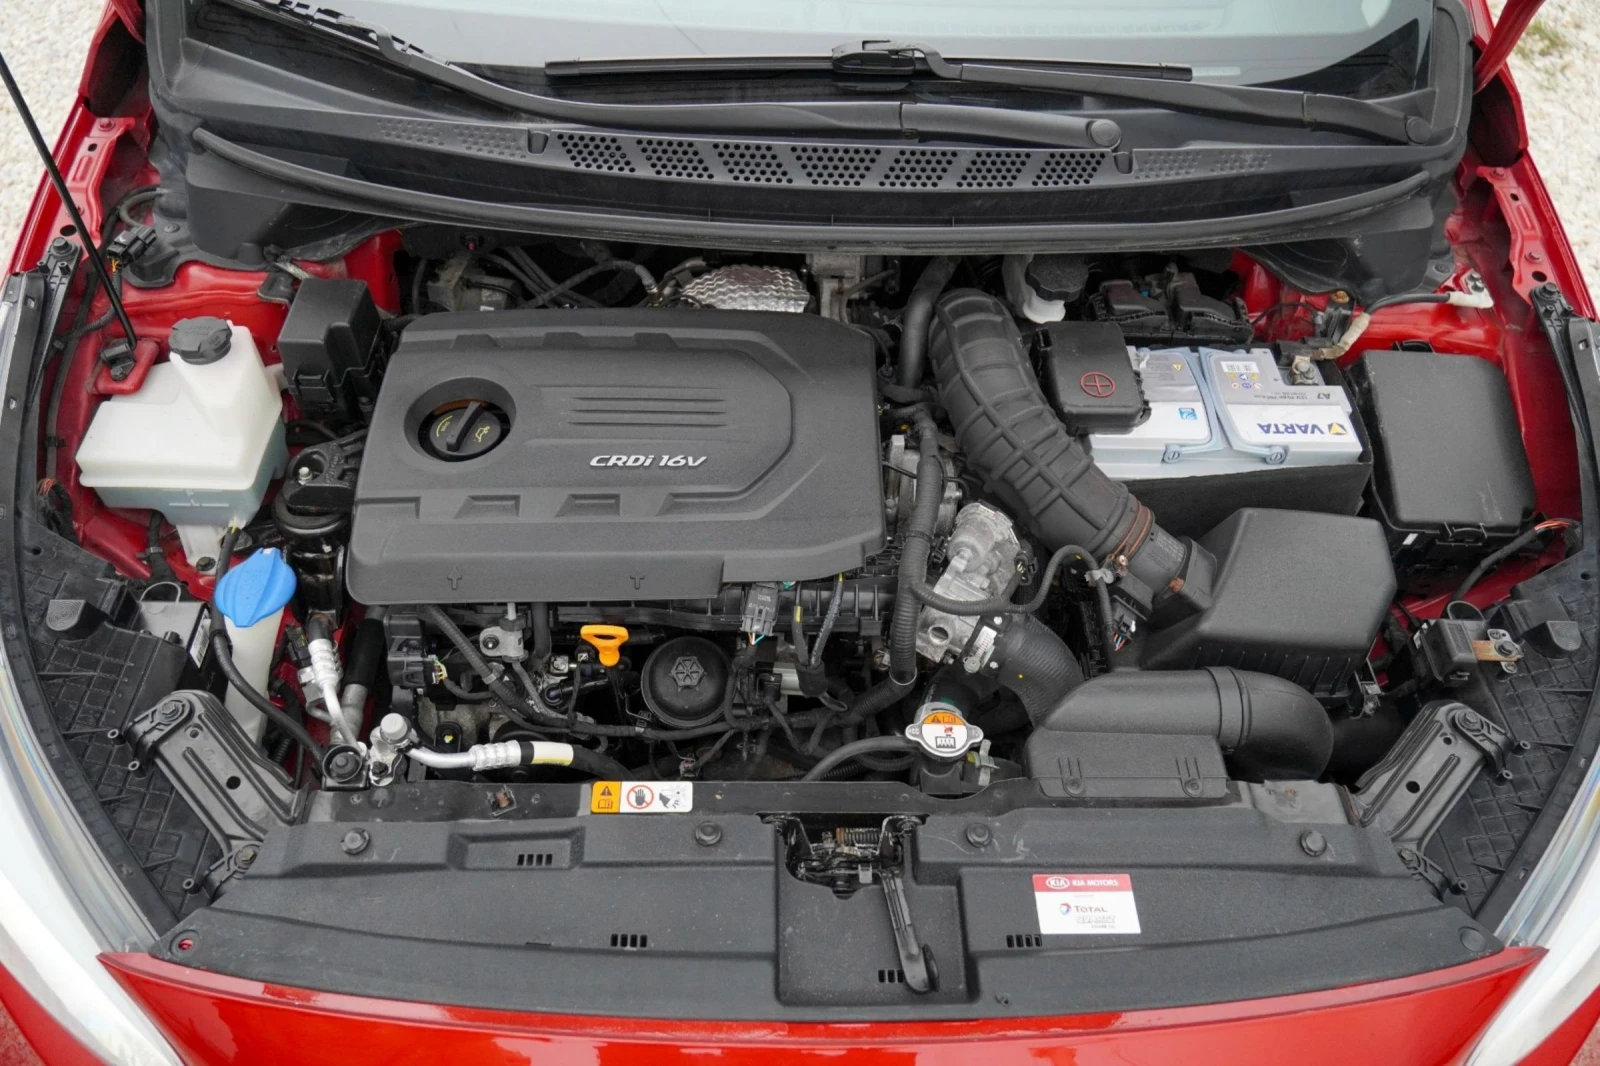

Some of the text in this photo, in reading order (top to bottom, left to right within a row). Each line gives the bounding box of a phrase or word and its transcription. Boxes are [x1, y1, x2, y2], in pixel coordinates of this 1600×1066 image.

[1257, 423, 1325, 435] VARTA
[589, 455, 707, 466] CRDi 16V
[1074, 905, 1108, 913] TOTAL
